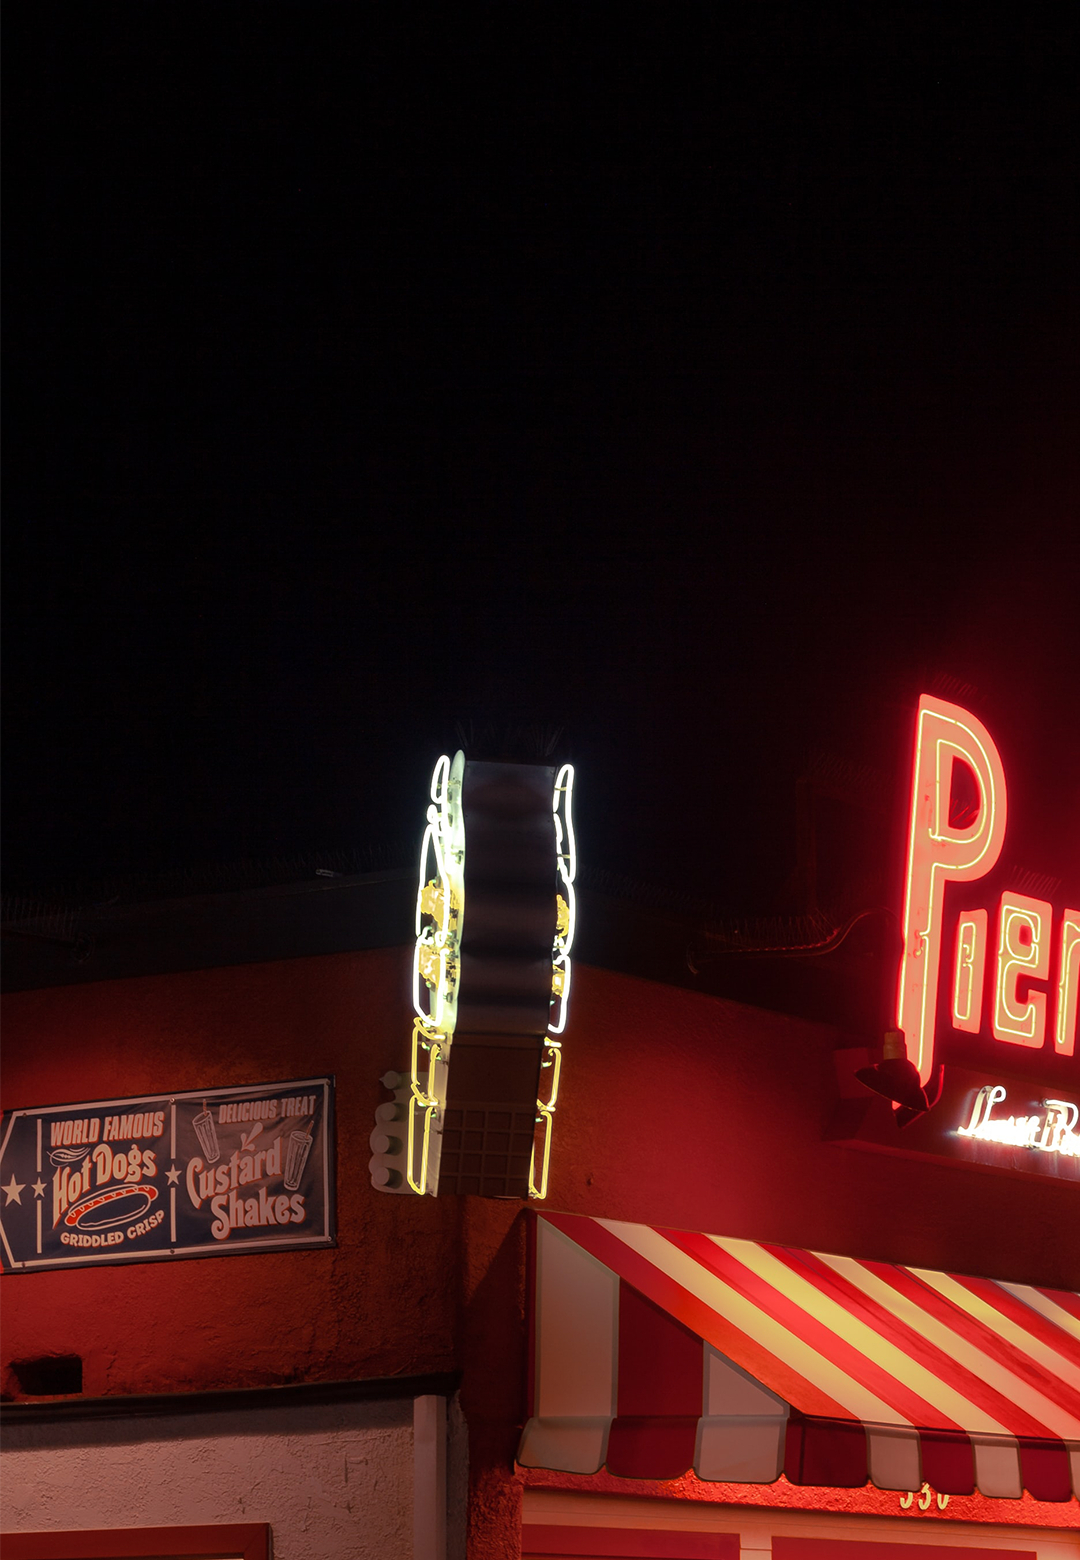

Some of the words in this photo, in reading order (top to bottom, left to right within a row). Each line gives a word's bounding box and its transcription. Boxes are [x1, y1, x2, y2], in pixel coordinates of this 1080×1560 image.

[50, 1117, 100, 1147] WORLD
[103, 1111, 165, 1143] FAMOUS
[218, 1098, 278, 1125] DELICIOUS
[280, 1095, 317, 1118] TREAT
[52, 1160, 92, 1230] Hot
[92, 1143, 158, 1187] Dogs
[186, 1136, 283, 1209] Custard
[60, 1230, 125, 1248] GRIDDLED
[126, 1209, 166, 1240] CRISP
[210, 1189, 305, 1240] Shakes
